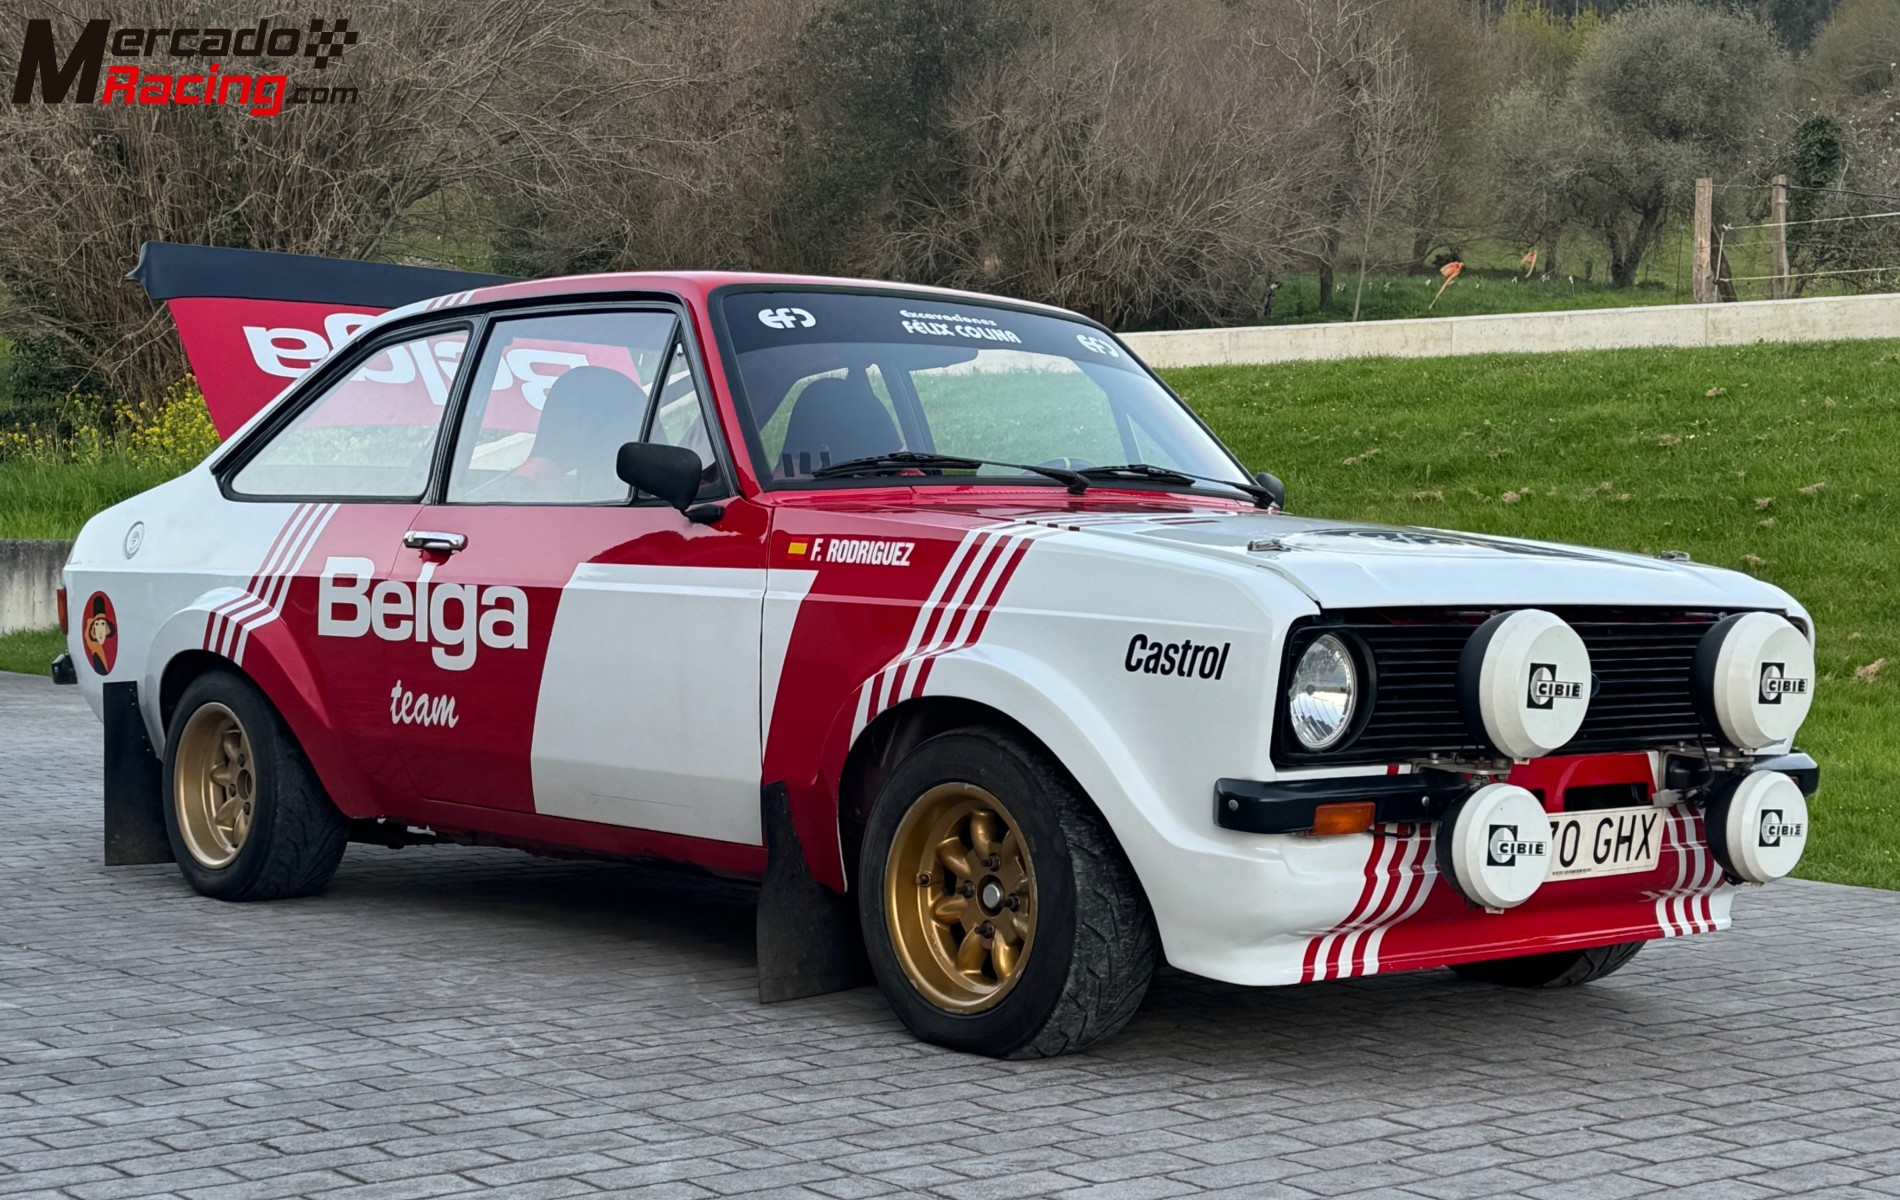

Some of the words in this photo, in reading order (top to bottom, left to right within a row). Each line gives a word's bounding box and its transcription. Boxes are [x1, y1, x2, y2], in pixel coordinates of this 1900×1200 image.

[954, 325, 1022, 343] COLINA
[810, 538, 823, 562] F.
[826, 538, 916, 567] RODRIGUEZ
[318, 556, 529, 671] Belga
[1125, 634, 1231, 680] Castrol
[390, 680, 459, 728] team
[1593, 813, 1658, 865] GHX
